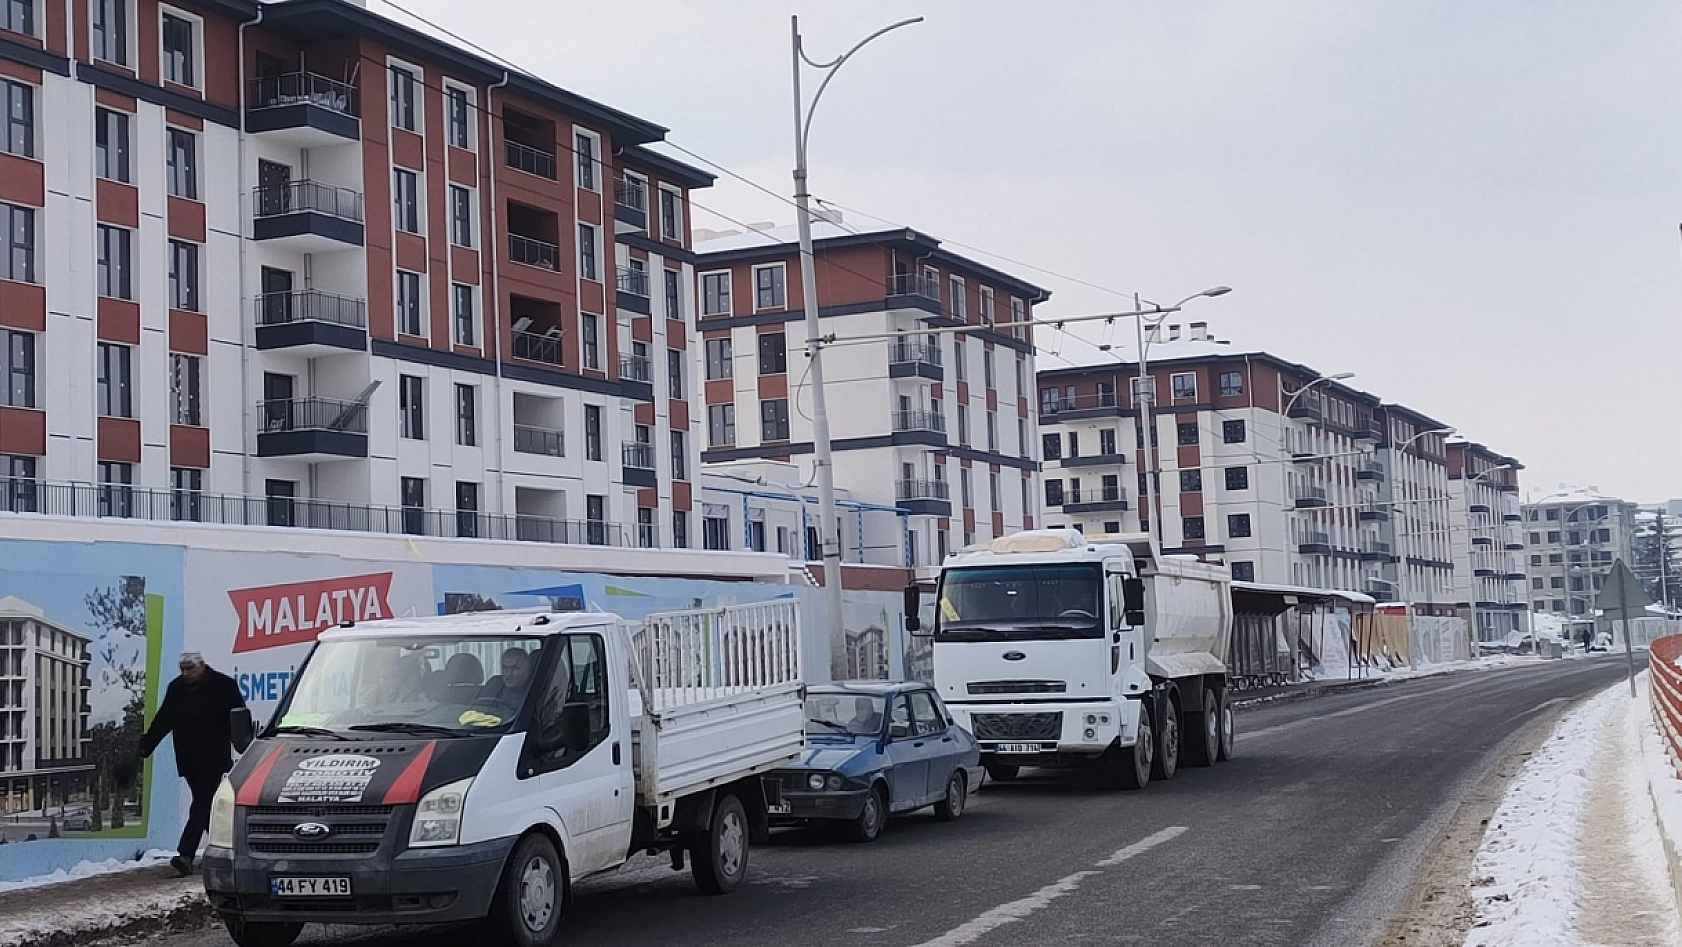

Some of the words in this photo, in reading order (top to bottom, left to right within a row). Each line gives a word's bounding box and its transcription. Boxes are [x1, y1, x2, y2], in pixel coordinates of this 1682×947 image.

[247, 586, 382, 638] MALATYA
[305, 759, 377, 768] YILDIRIM
[297, 795, 340, 803] MALATYA
[278, 879, 294, 894] 44
[299, 879, 317, 894] FY
[322, 879, 348, 894] 419
